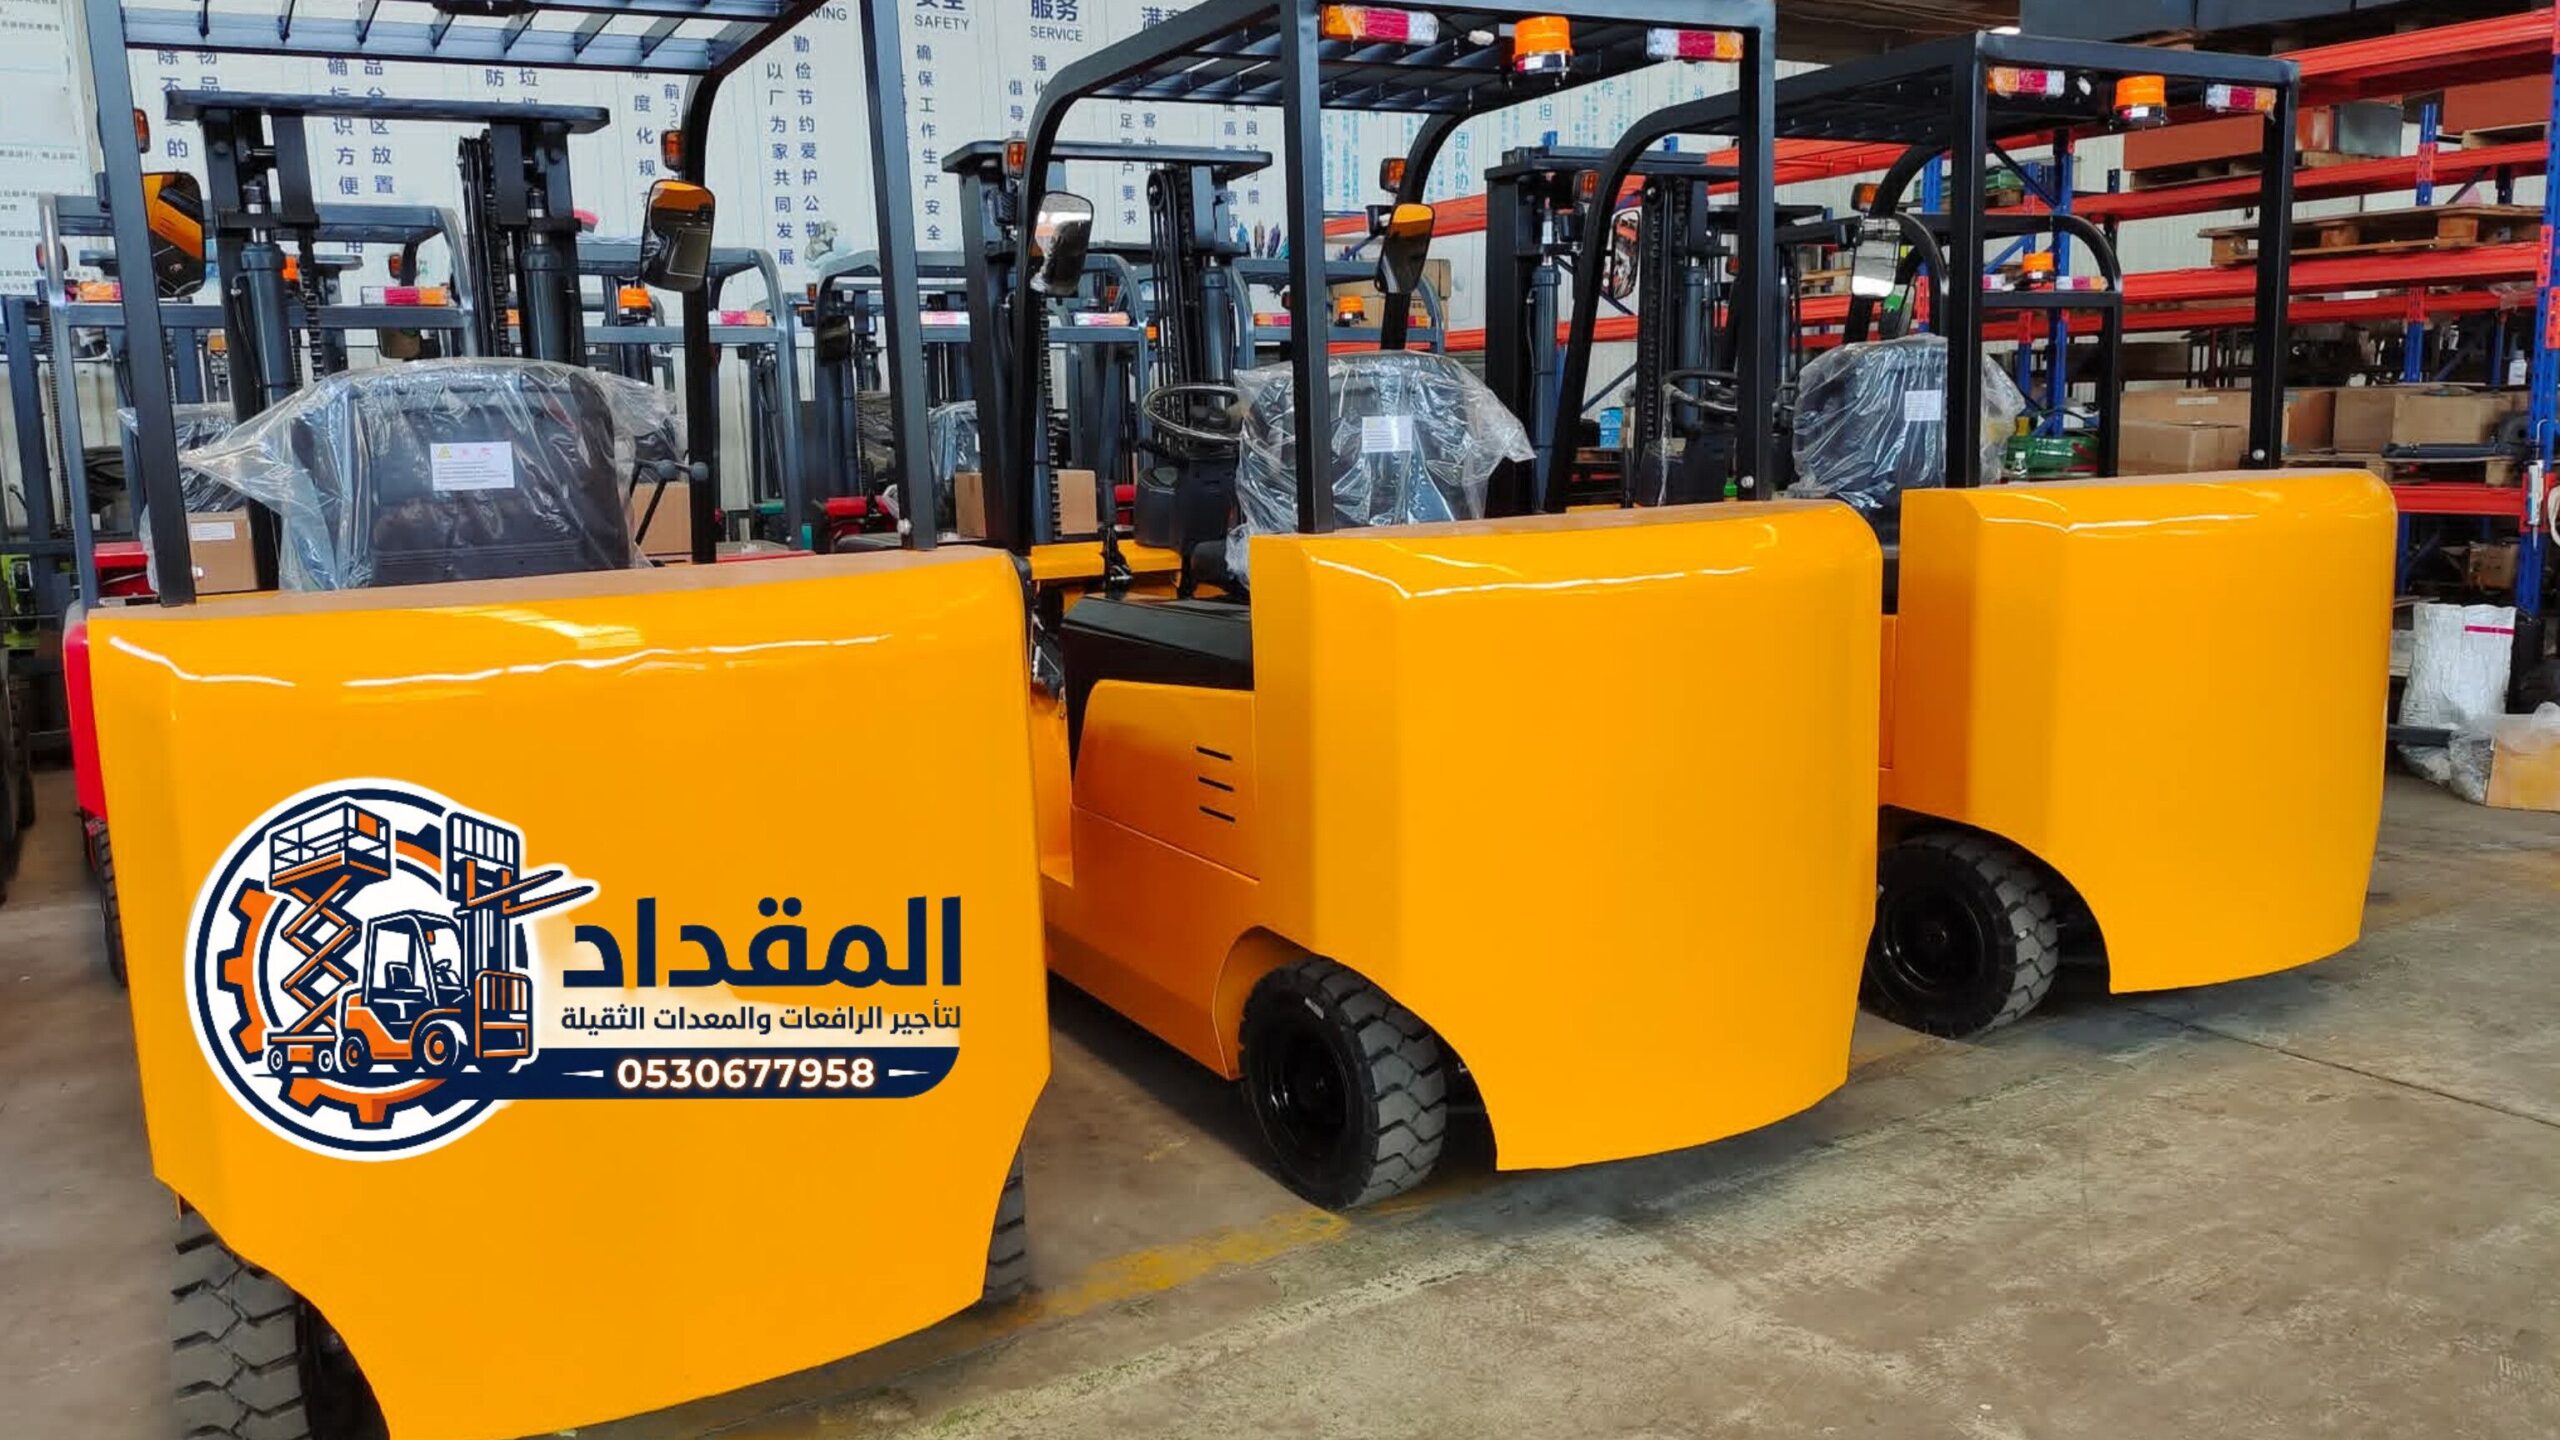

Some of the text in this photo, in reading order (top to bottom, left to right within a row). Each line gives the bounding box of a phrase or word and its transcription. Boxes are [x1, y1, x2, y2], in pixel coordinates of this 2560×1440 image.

[914, 14, 970, 31] SAFETY
[1030, 0, 1079, 22] 服务
[1030, 26, 1083, 42] SERVICE
[766, 63, 796, 266] 以厂为家共同发展
[793, 35, 822, 239] 勤俭节约爱护公物
[916, 44, 942, 241] 确保工作生产安全
